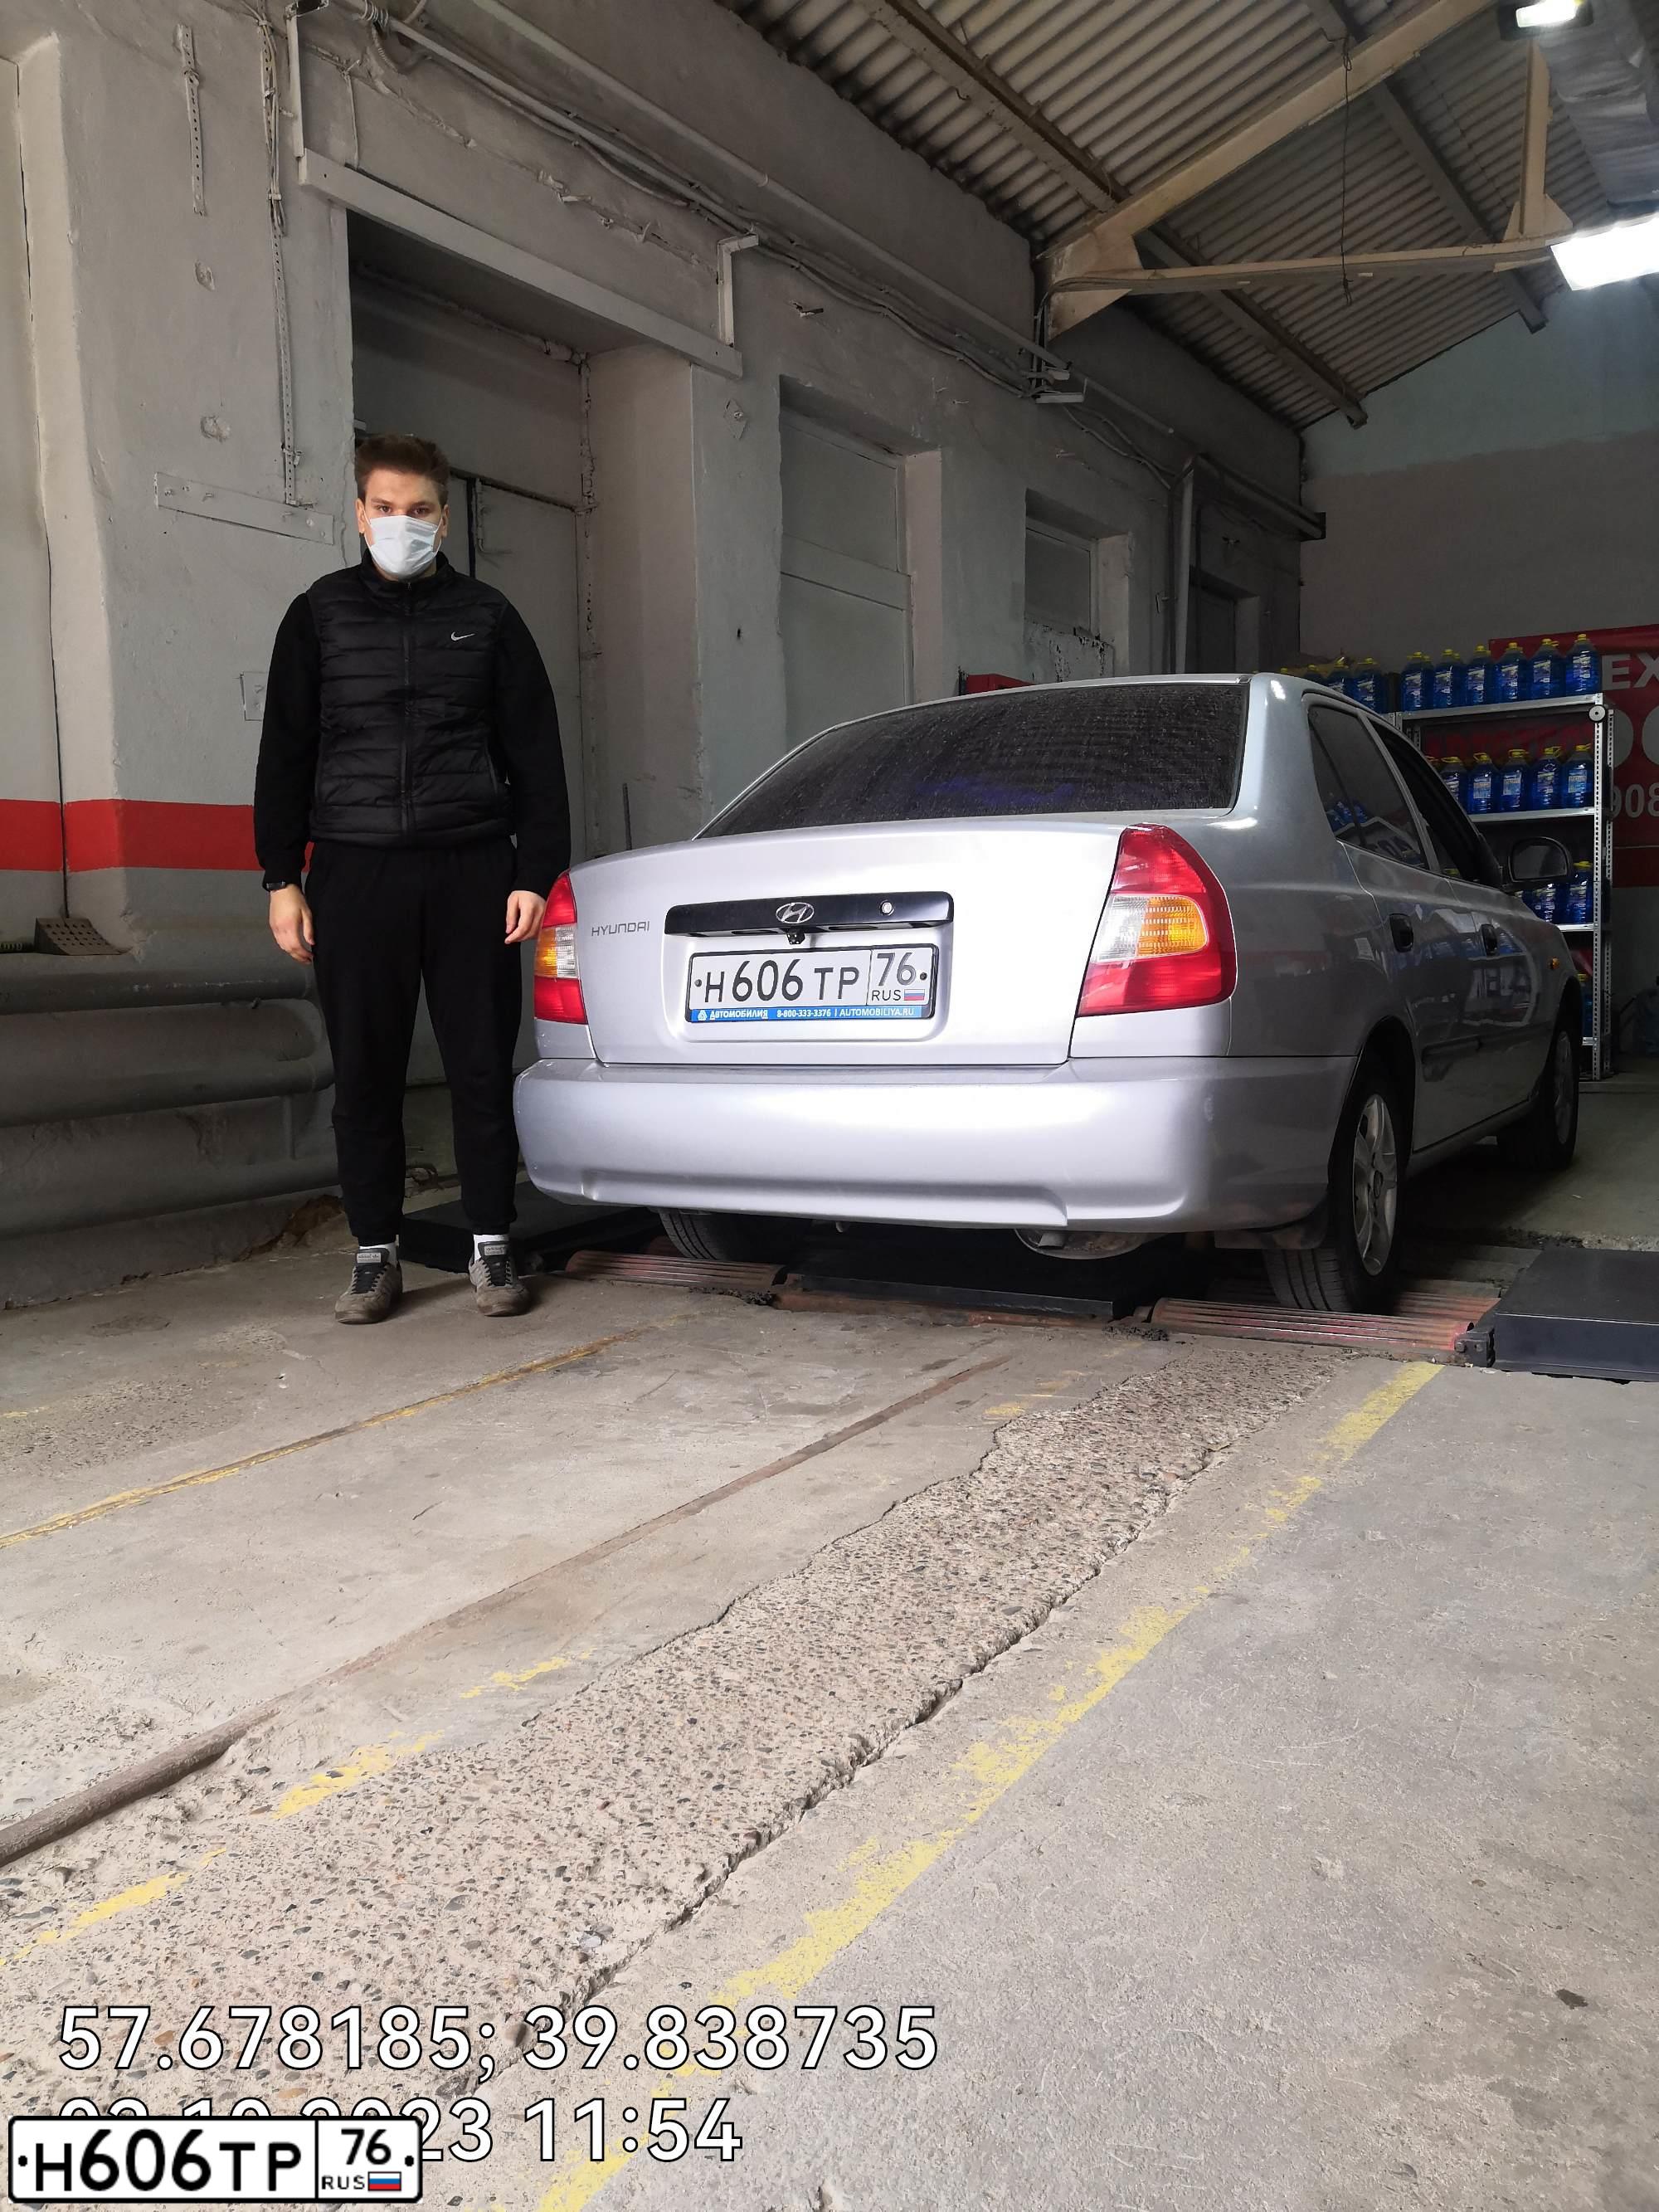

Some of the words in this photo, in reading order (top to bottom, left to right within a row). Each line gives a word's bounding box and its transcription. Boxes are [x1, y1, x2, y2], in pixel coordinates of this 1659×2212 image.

[591, 920, 650, 937] HYUNDAI
[876, 952, 917, 987] 76
[871, 989, 902, 1001] RUS
[776, 1008, 831, 1018] 8-800-333-3376
[839, 1007, 914, 1017] AUTOMOBILIYA.RU
